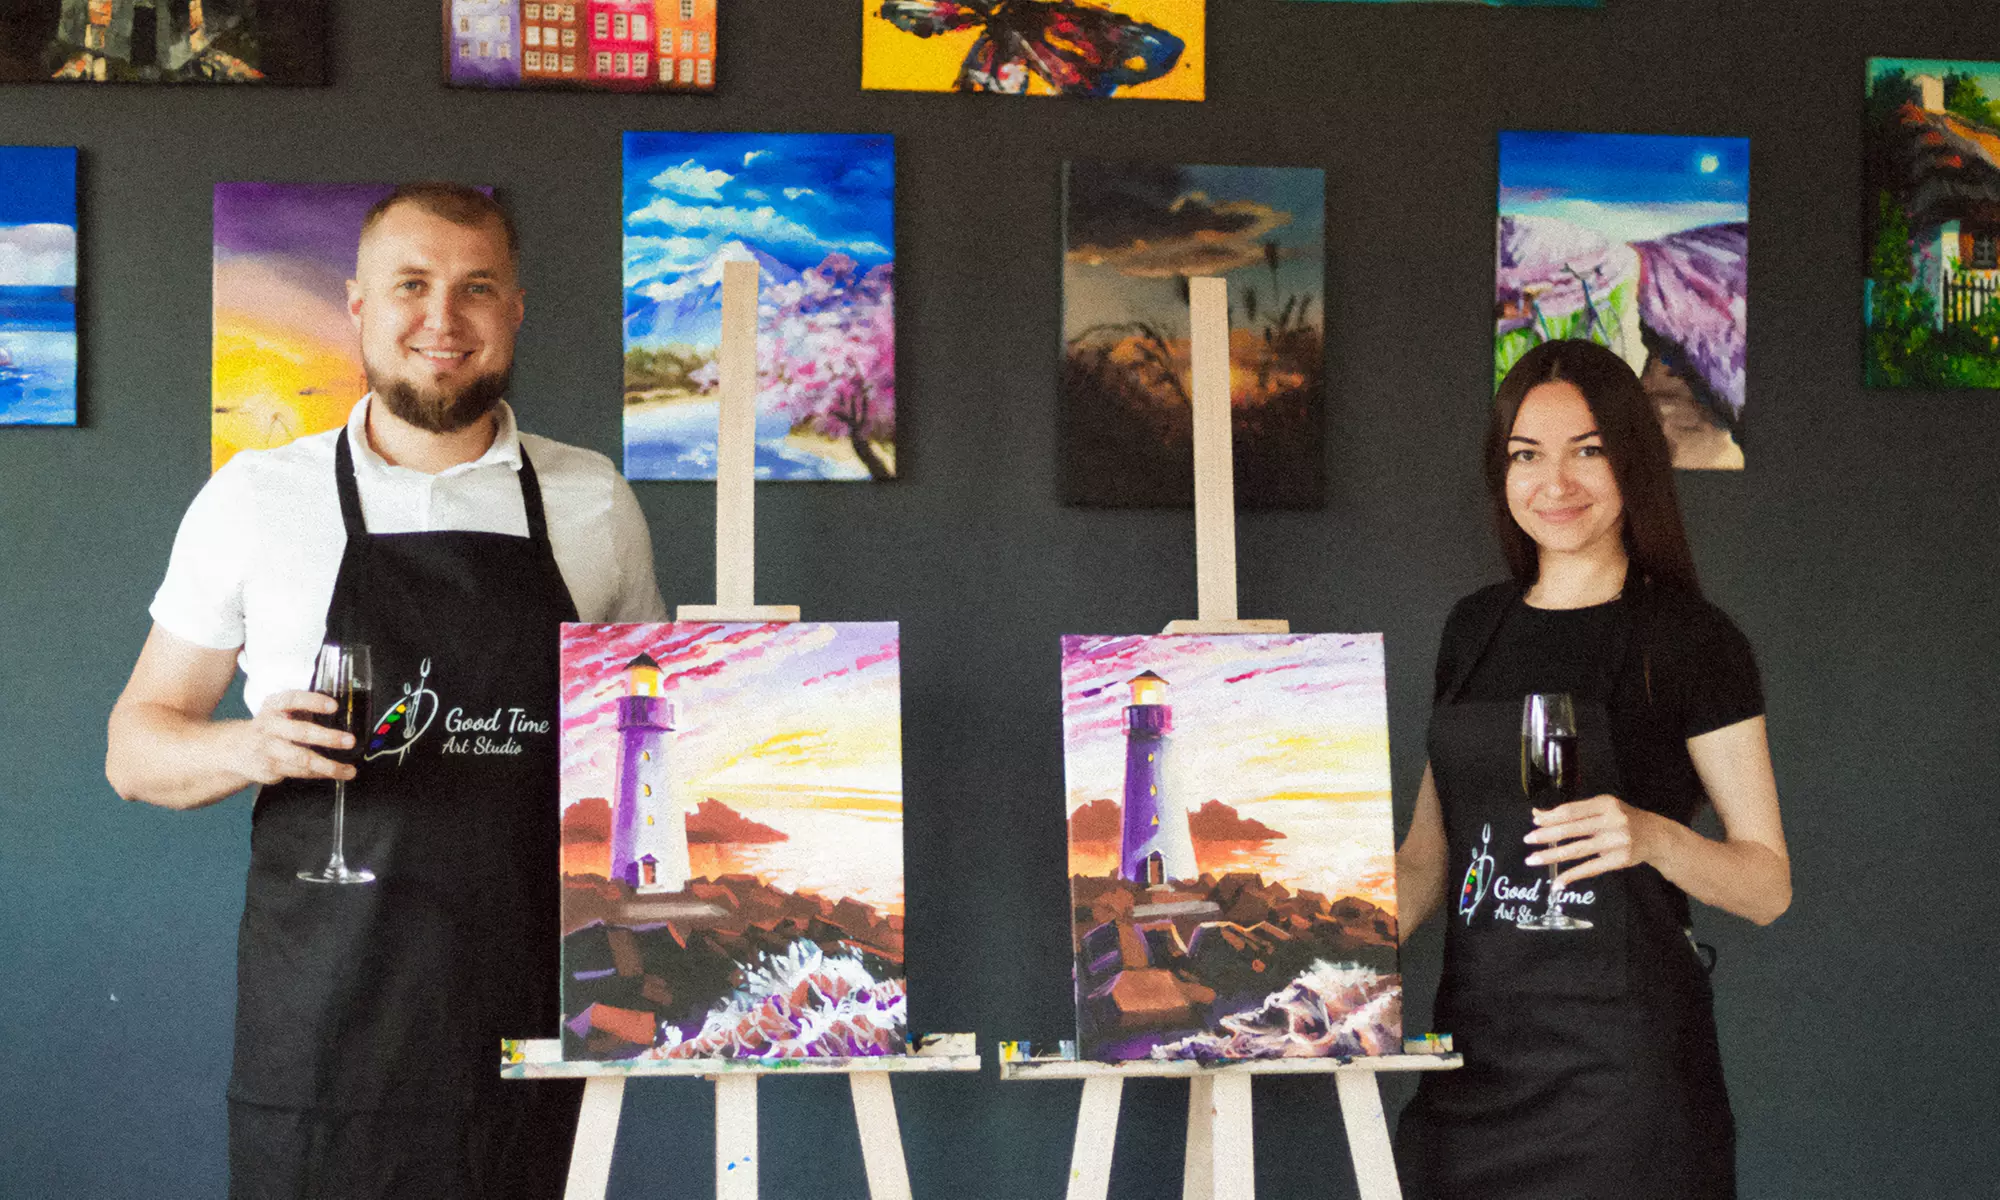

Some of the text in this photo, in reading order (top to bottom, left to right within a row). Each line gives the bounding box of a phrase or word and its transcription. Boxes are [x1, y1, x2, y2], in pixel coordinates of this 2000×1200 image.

[445, 707, 549, 734] Good Time
[442, 736, 523, 755] Art Studio
[1494, 876, 1542, 901] Good
[1494, 902, 1516, 920] Art
